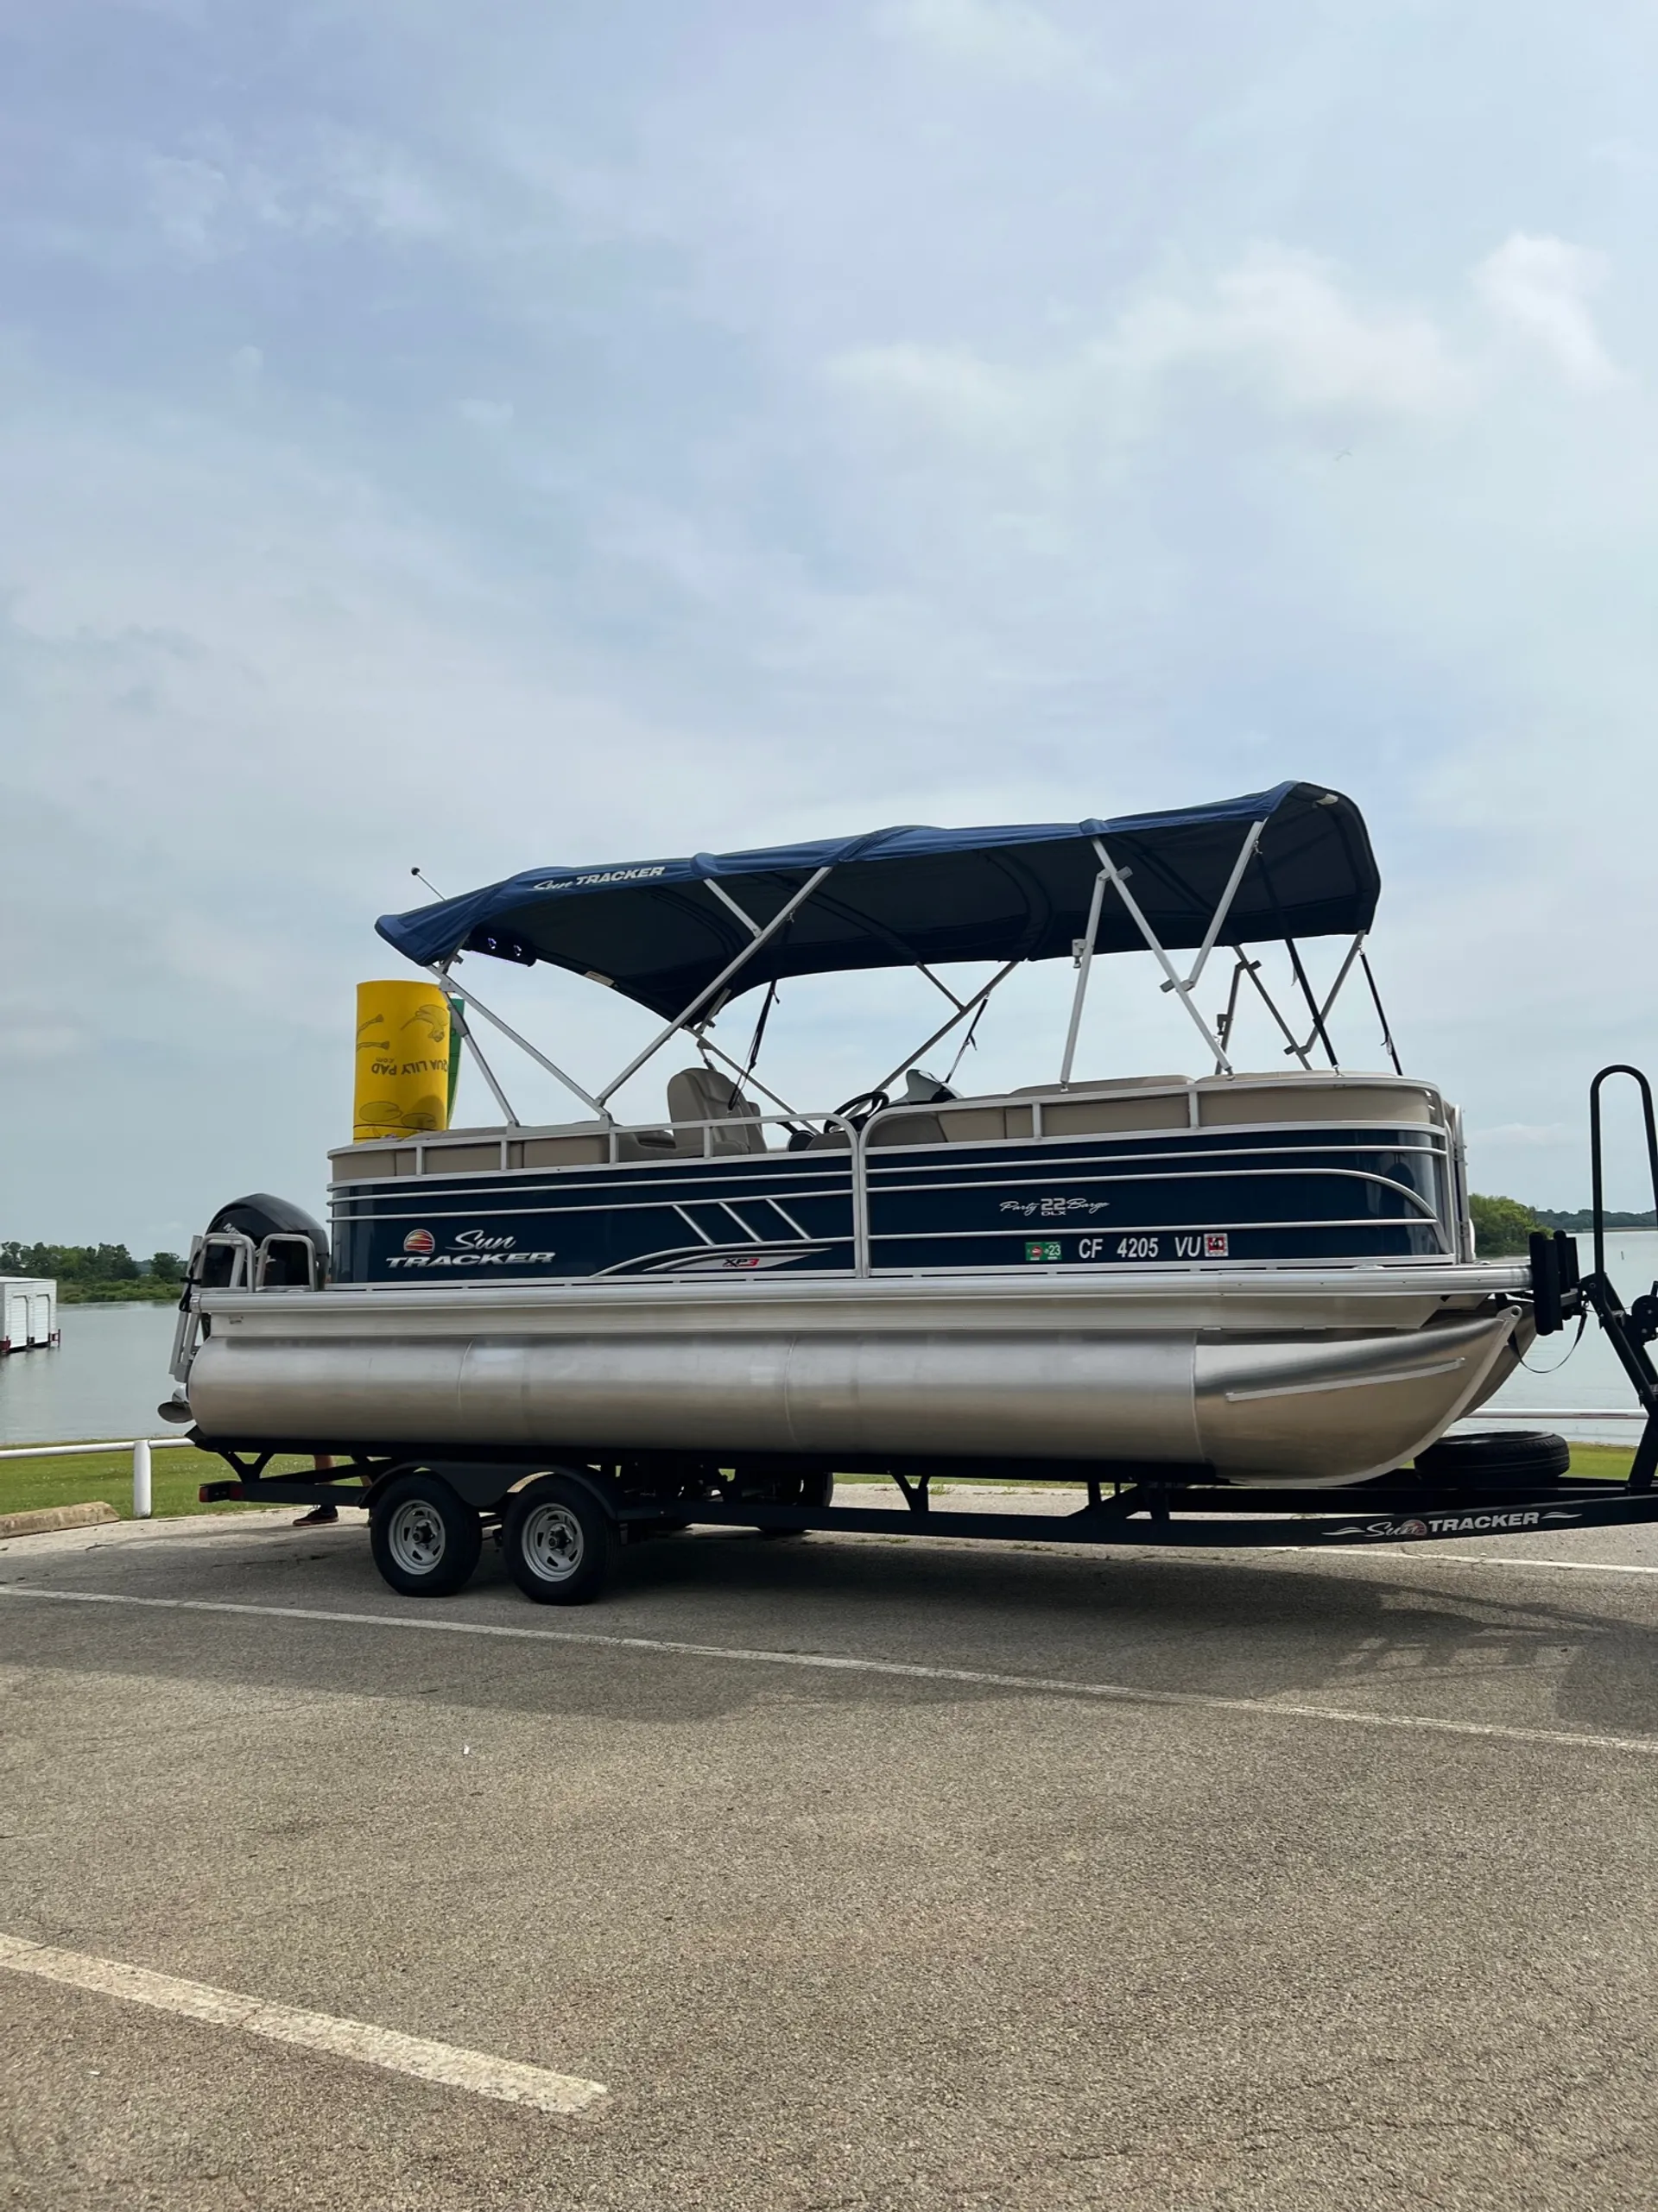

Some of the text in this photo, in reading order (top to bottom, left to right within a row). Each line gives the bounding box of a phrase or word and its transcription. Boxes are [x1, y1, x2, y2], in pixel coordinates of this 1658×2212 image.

[576, 866, 666, 886] TRACKER
[371, 1062, 397, 1076] PAD
[401, 1060, 428, 1075] LILY
[999, 1198, 1111, 1217] Party 22 Barge
[445, 1229, 516, 1251] Sun
[1079, 1238, 1104, 1259] CF
[1117, 1237, 1159, 1258] 4205
[1174, 1236, 1202, 1257] VU
[1047, 1244, 1061, 1256] 23
[385, 1252, 557, 1269] TRACKER
[1364, 1512, 1540, 1538] Sun TRACKER
